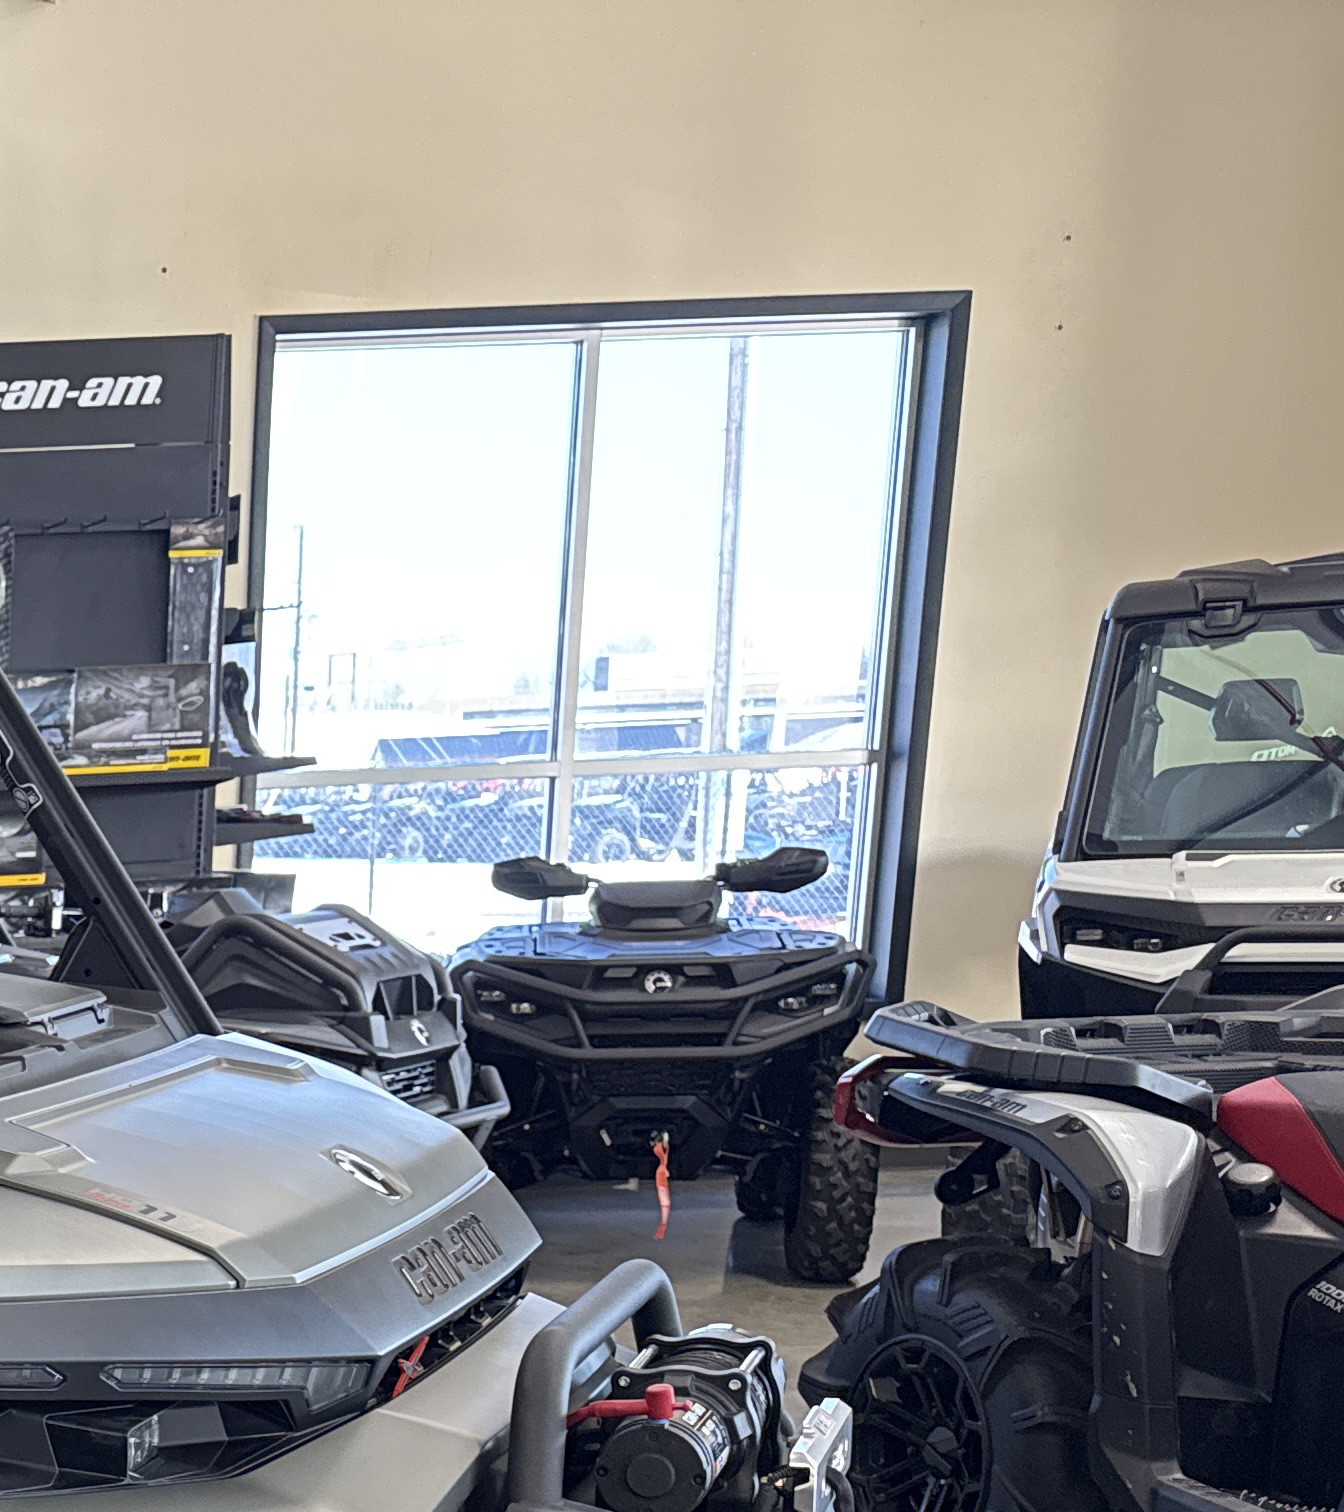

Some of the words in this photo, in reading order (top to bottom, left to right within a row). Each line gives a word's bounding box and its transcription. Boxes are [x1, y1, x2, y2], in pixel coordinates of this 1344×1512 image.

[392, 1211, 503, 1307] can-am
[1307, 1287, 1344, 1313] ROTAX
[1315, 1280, 1344, 1303] 100
